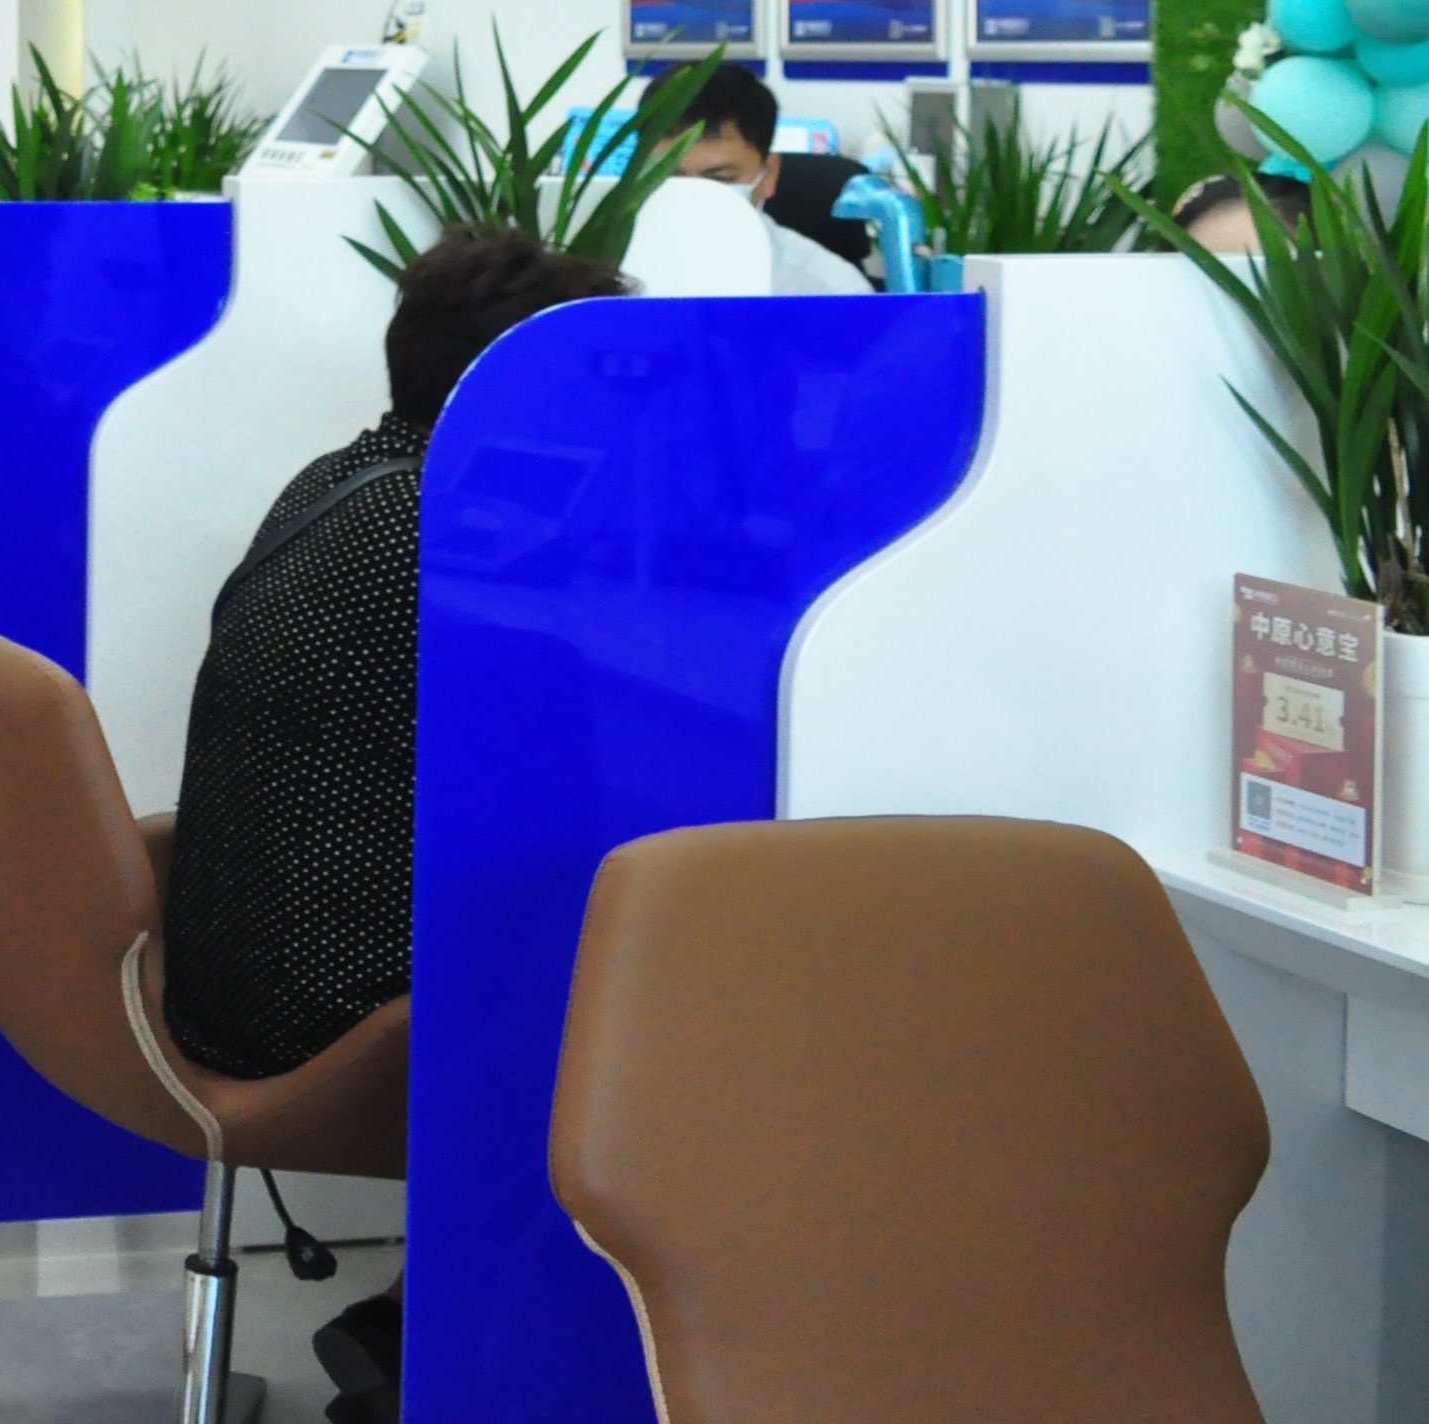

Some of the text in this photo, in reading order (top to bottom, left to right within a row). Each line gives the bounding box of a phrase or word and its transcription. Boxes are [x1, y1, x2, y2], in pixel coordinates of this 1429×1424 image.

[1249, 610, 1360, 664] 中原心意宝
